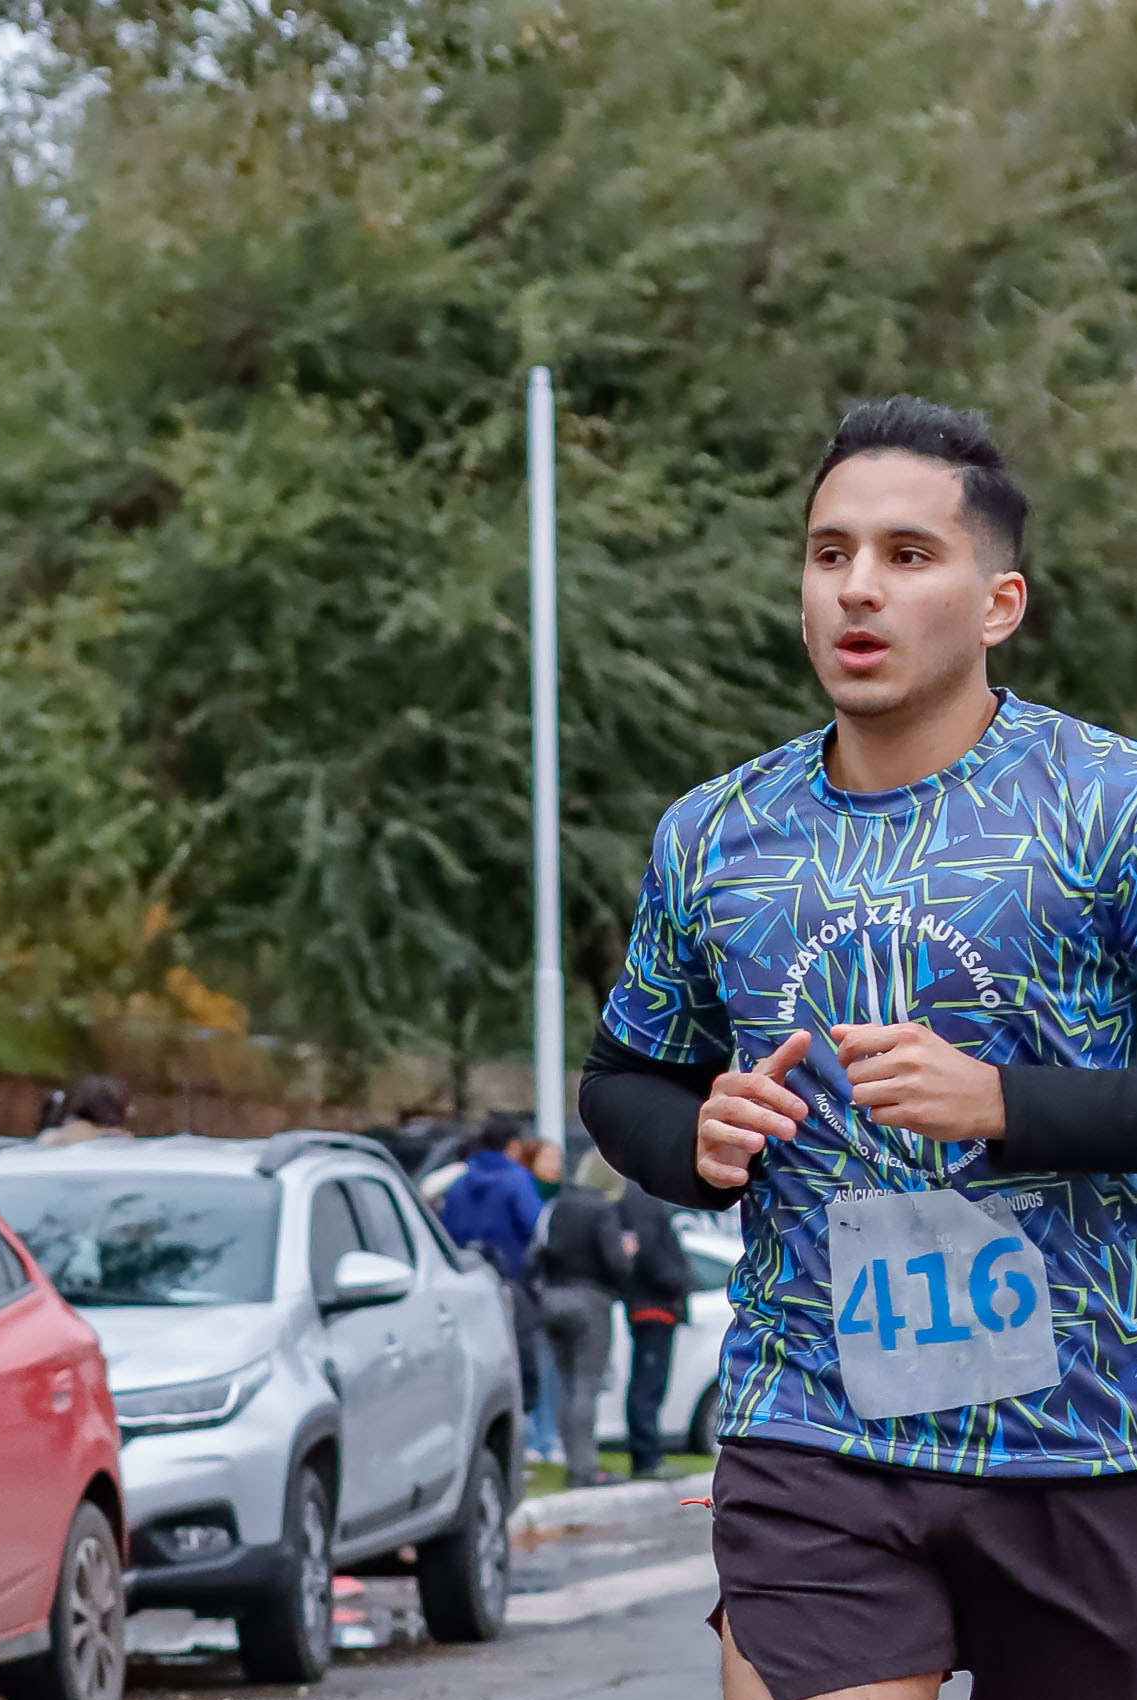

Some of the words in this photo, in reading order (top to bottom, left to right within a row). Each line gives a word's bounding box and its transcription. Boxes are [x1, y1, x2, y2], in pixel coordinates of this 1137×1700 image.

[777, 911, 857, 1024] MARATÓN
[864, 906, 881, 927] X
[887, 906, 912, 926] EL
[916, 914, 1001, 1009] AUTISMO
[947, 1138, 987, 1175] ENERGÍ
[1005, 1191, 1044, 1212] NIDOS
[837, 1236, 1038, 1351] 416
